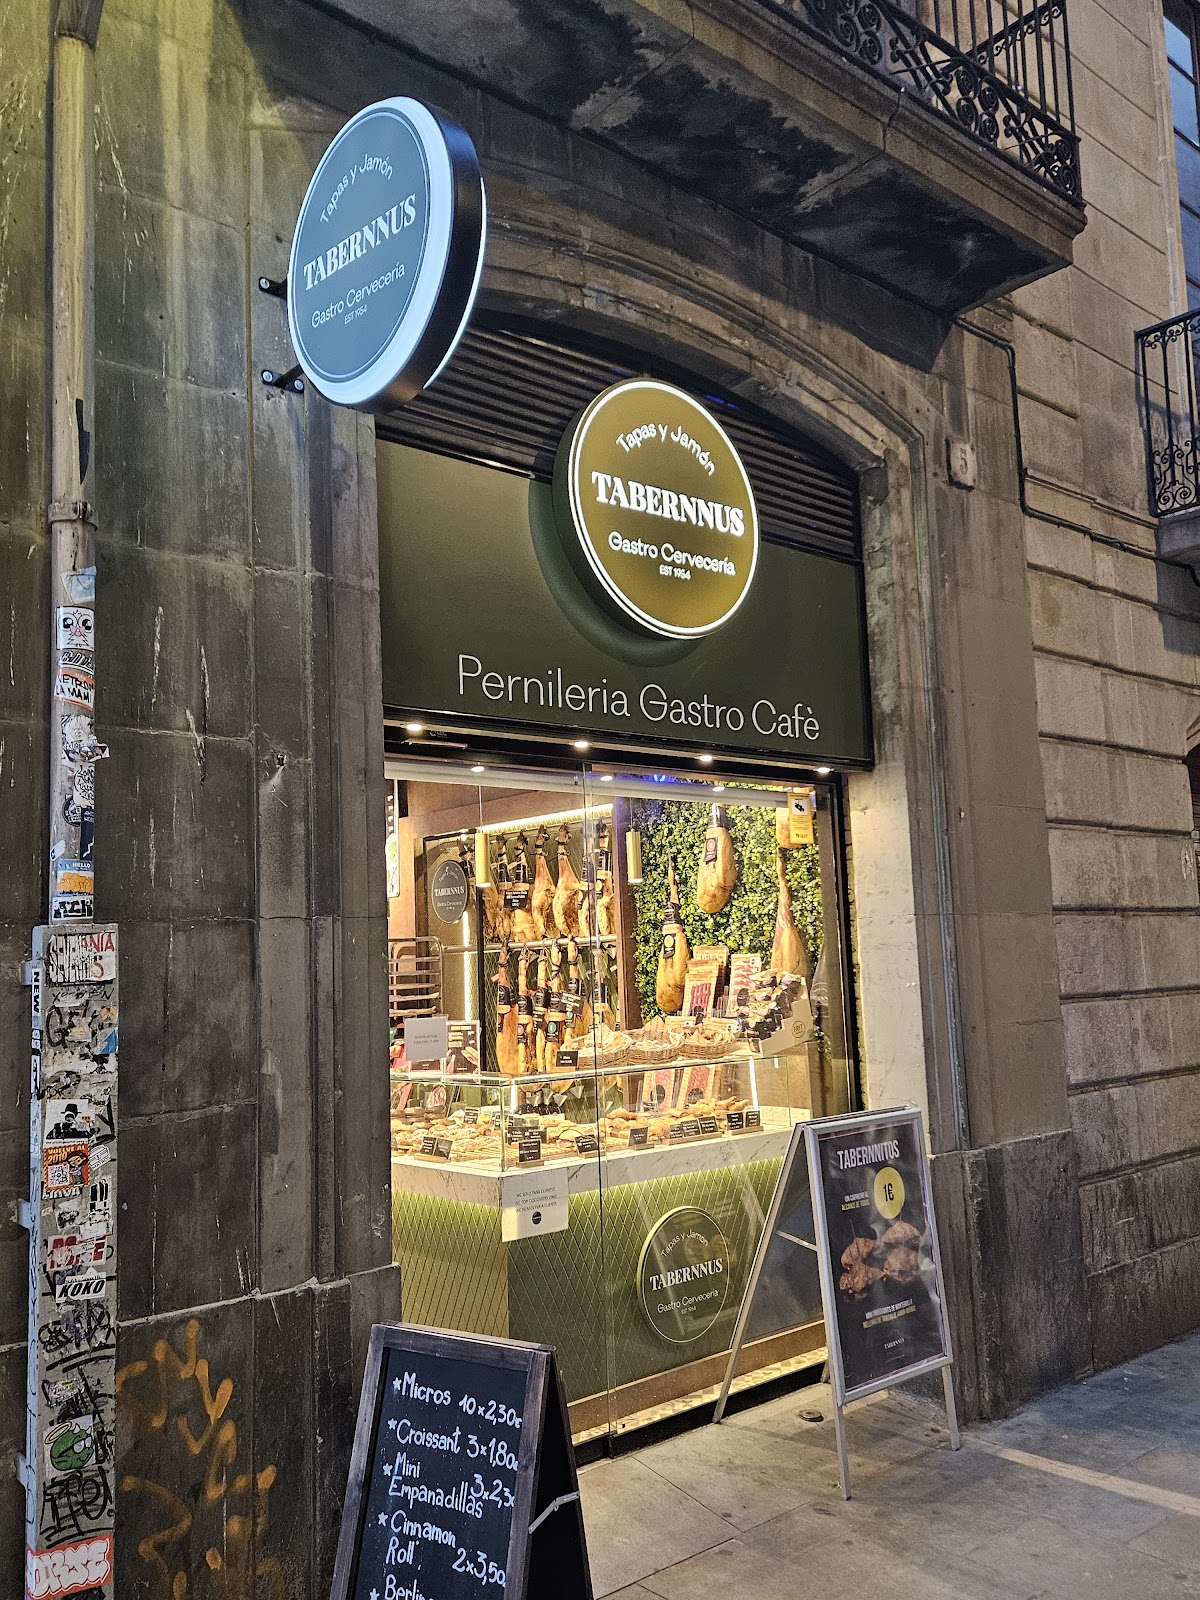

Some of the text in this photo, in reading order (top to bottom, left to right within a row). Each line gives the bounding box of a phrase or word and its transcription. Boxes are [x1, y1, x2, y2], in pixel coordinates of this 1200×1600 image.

[320, 153, 393, 224] Tapas y Jamón
[303, 193, 416, 290] TABERNNUS
[311, 261, 405, 329] Gastro Cervecería
[344, 312, 354, 325] EST
[615, 423, 716, 476] Tapas y Jamón
[591, 471, 745, 537] TABERNNUS
[608, 531, 736, 576] Gastro Cervecería
[659, 564, 691, 580] EST 1954
[458, 654, 820, 741] Pernileria Gastro Cafè
[837, 1139, 900, 1170] TABERNNITOS
[883, 1183, 894, 1201] 1€
[660, 1235, 680, 1257] Tapas
[680, 1232, 686, 1241] y
[58, 1279, 105, 1298] KOKO
[650, 1258, 723, 1291] TABERNNUS
[657, 1301, 680, 1313] Gastro
[401, 1371, 452, 1406] Micros
[396, 1418, 461, 1455] Croissant
[394, 1452, 421, 1478] Mini
[389, 1476, 484, 1519] Empanadillas
[390, 1510, 456, 1548] Cinnamon
[386, 1536, 507, 1588] Roll 2x3,50
